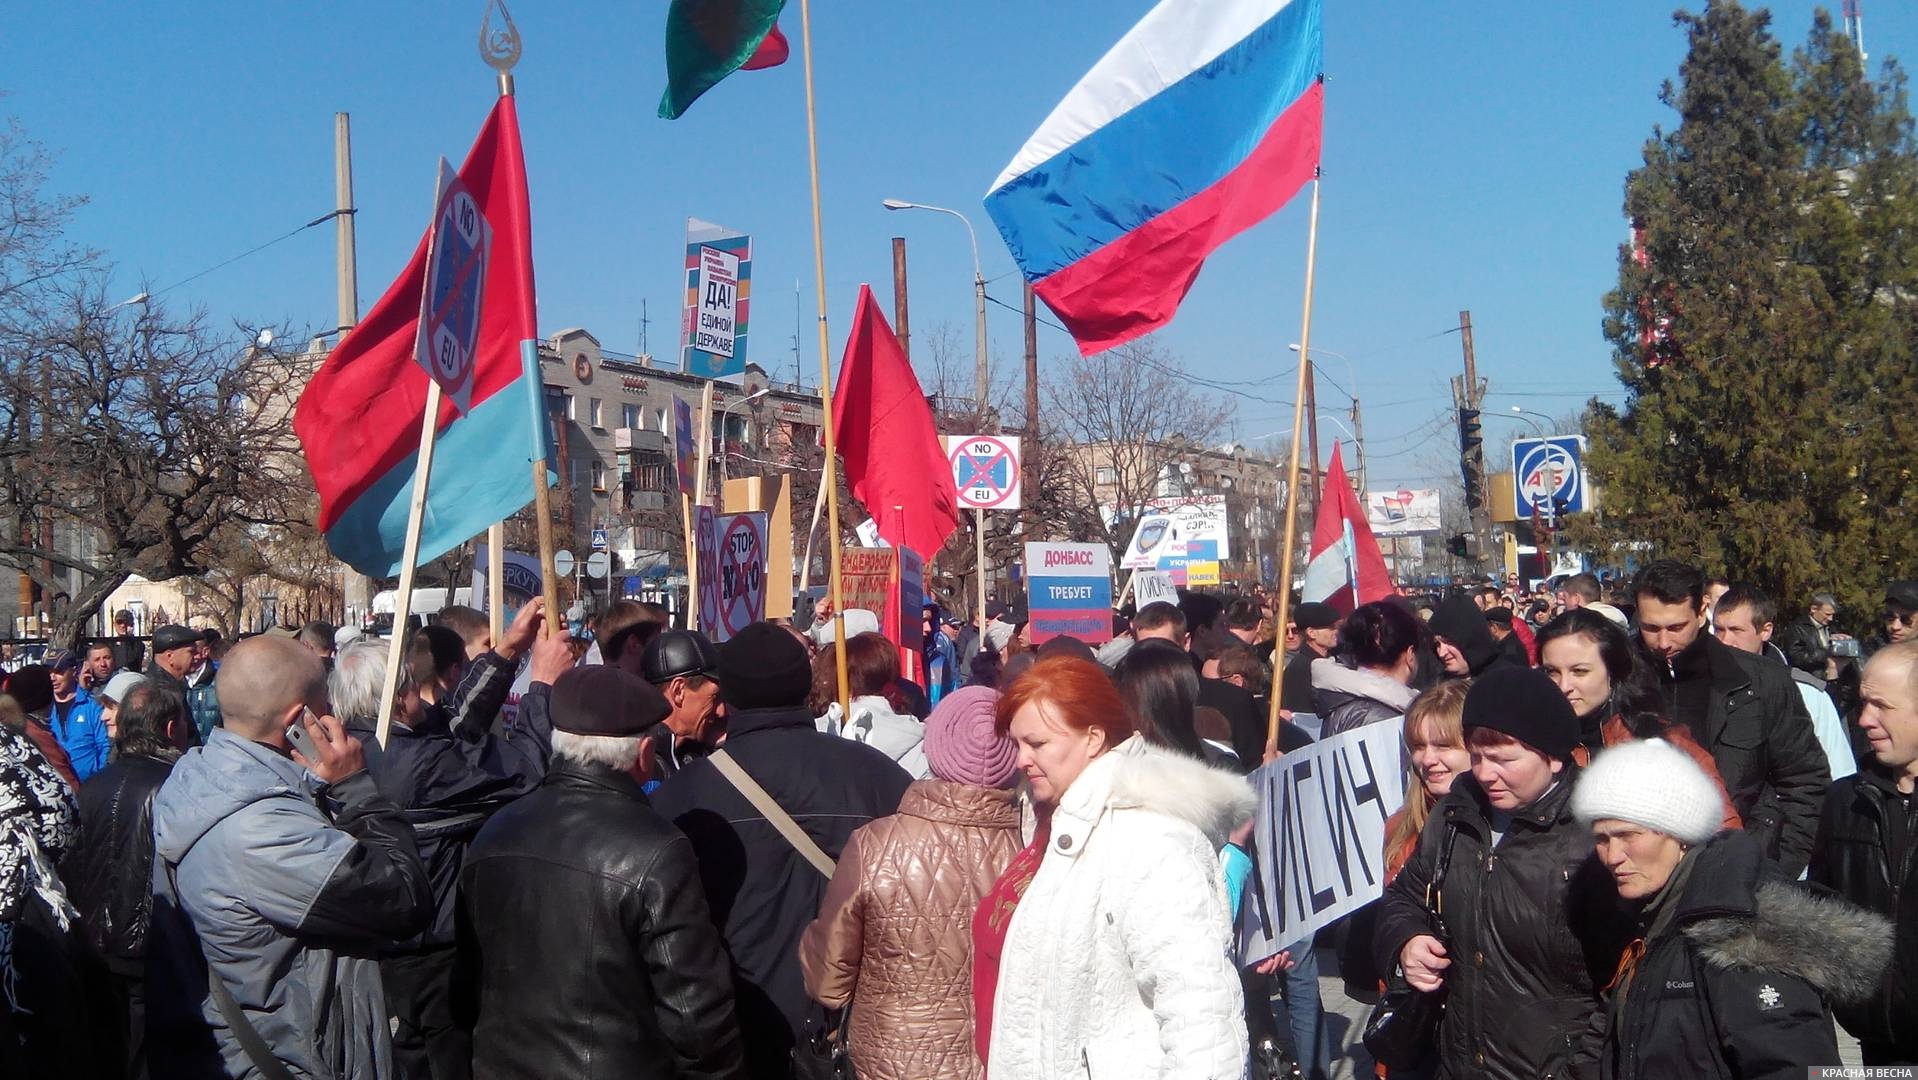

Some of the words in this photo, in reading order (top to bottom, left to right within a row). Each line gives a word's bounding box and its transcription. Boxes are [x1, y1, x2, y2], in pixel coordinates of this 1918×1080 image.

[459, 198, 474, 237] NO
[705, 280, 731, 310] ДА!
[701, 312, 731, 333] ЕДИНОЙ
[441, 335, 455, 371] EU
[697, 332, 732, 353] ДЕРЖАВЕ
[974, 444, 992, 454] NO
[975, 490, 990, 500] EU
[730, 532, 754, 554] STOP
[1044, 550, 1094, 568] ДОНБАСС
[502, 567, 537, 593] ЕРКУТ
[1048, 586, 1093, 600] ТРЕБУЕТ
